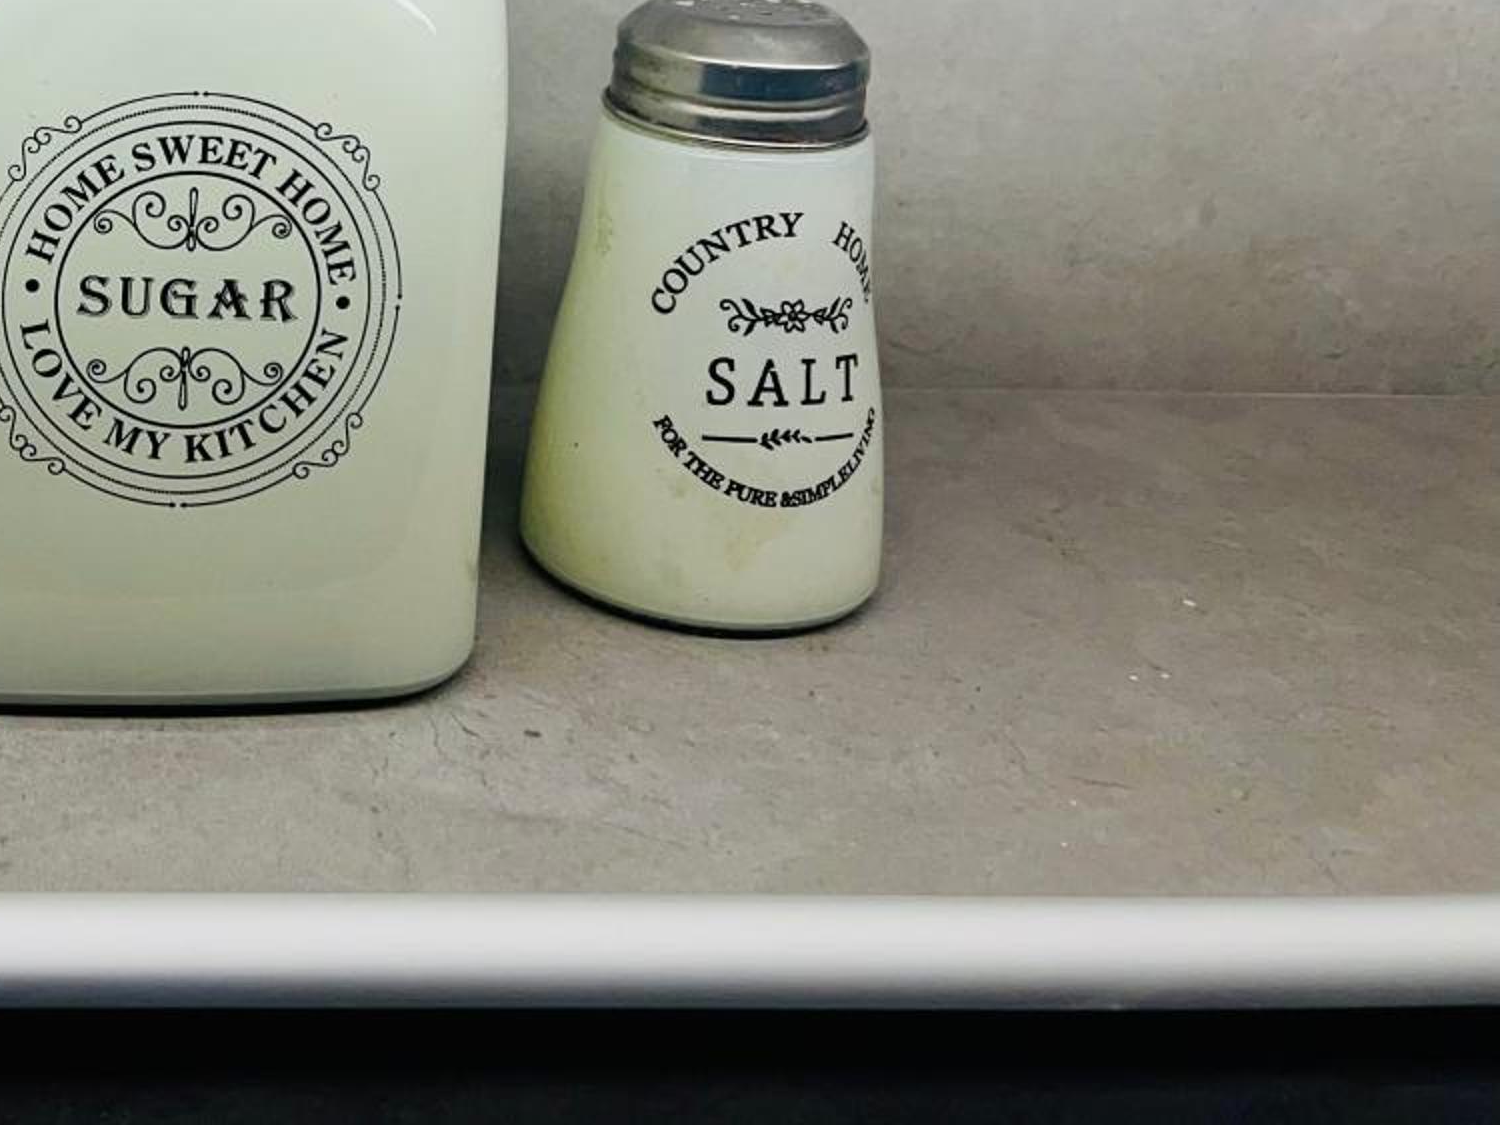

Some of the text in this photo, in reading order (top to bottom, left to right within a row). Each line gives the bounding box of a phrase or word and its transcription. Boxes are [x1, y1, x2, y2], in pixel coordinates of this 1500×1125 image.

[24, 133, 358, 288] HOME SWEET HOME
[75, 274, 299, 323] SUGAR
[650, 211, 806, 316] COUNTRY
[19, 318, 350, 465] LOVE MY KITCHEN
[705, 352, 860, 408] SALT
[652, 414, 689, 459] FOR
[682, 450, 727, 491] THE
[723, 478, 778, 508] PURE
